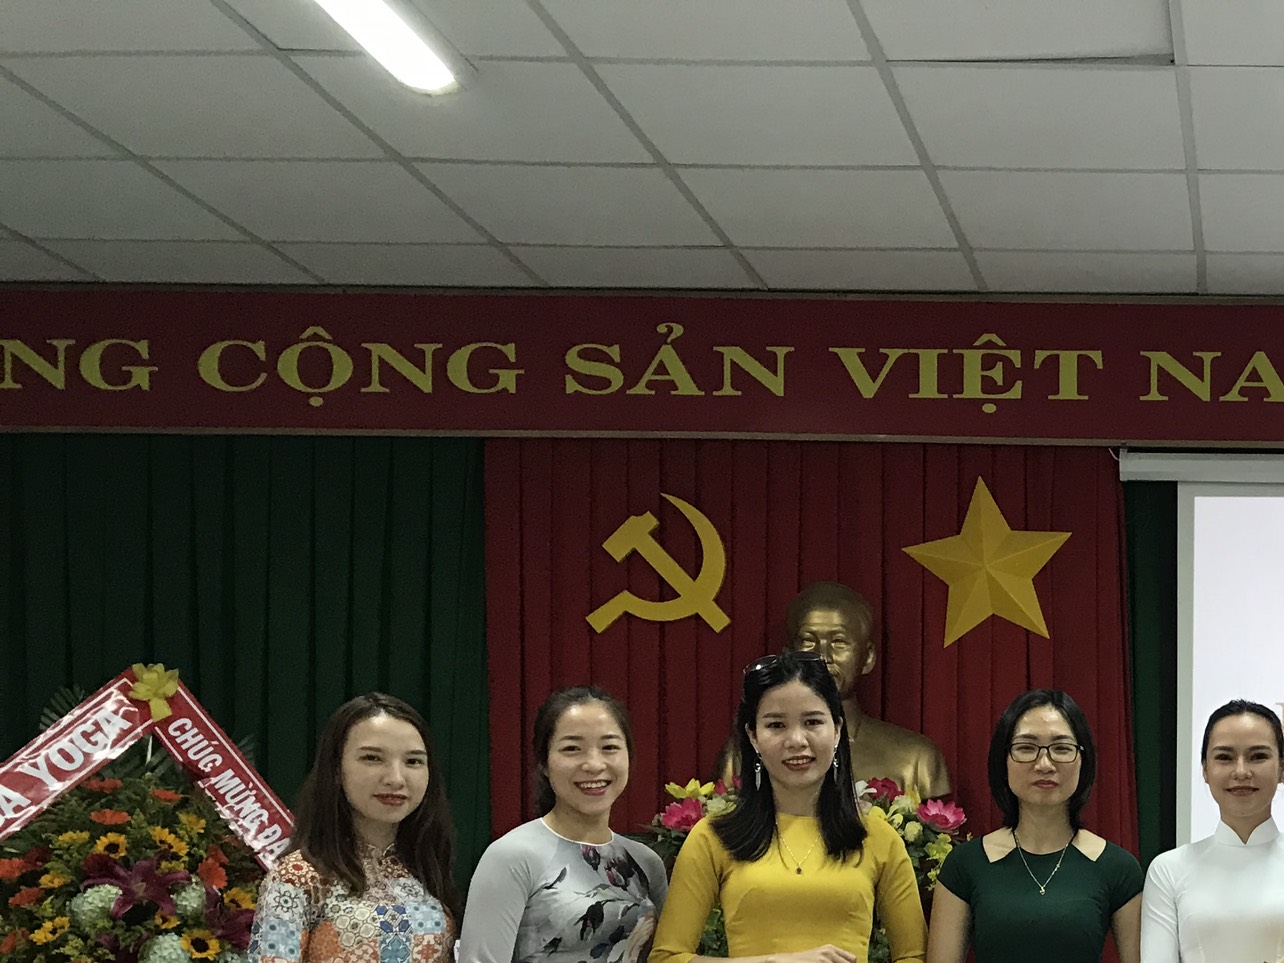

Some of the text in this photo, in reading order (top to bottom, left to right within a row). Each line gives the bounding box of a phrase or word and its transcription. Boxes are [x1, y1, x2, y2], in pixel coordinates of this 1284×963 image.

[0, 338, 159, 391] NG
[198, 326, 525, 407] CỘNG
[564, 322, 795, 398] SẢN
[828, 332, 1105, 415] VIỆT
[18, 706, 133, 791] YOGA
